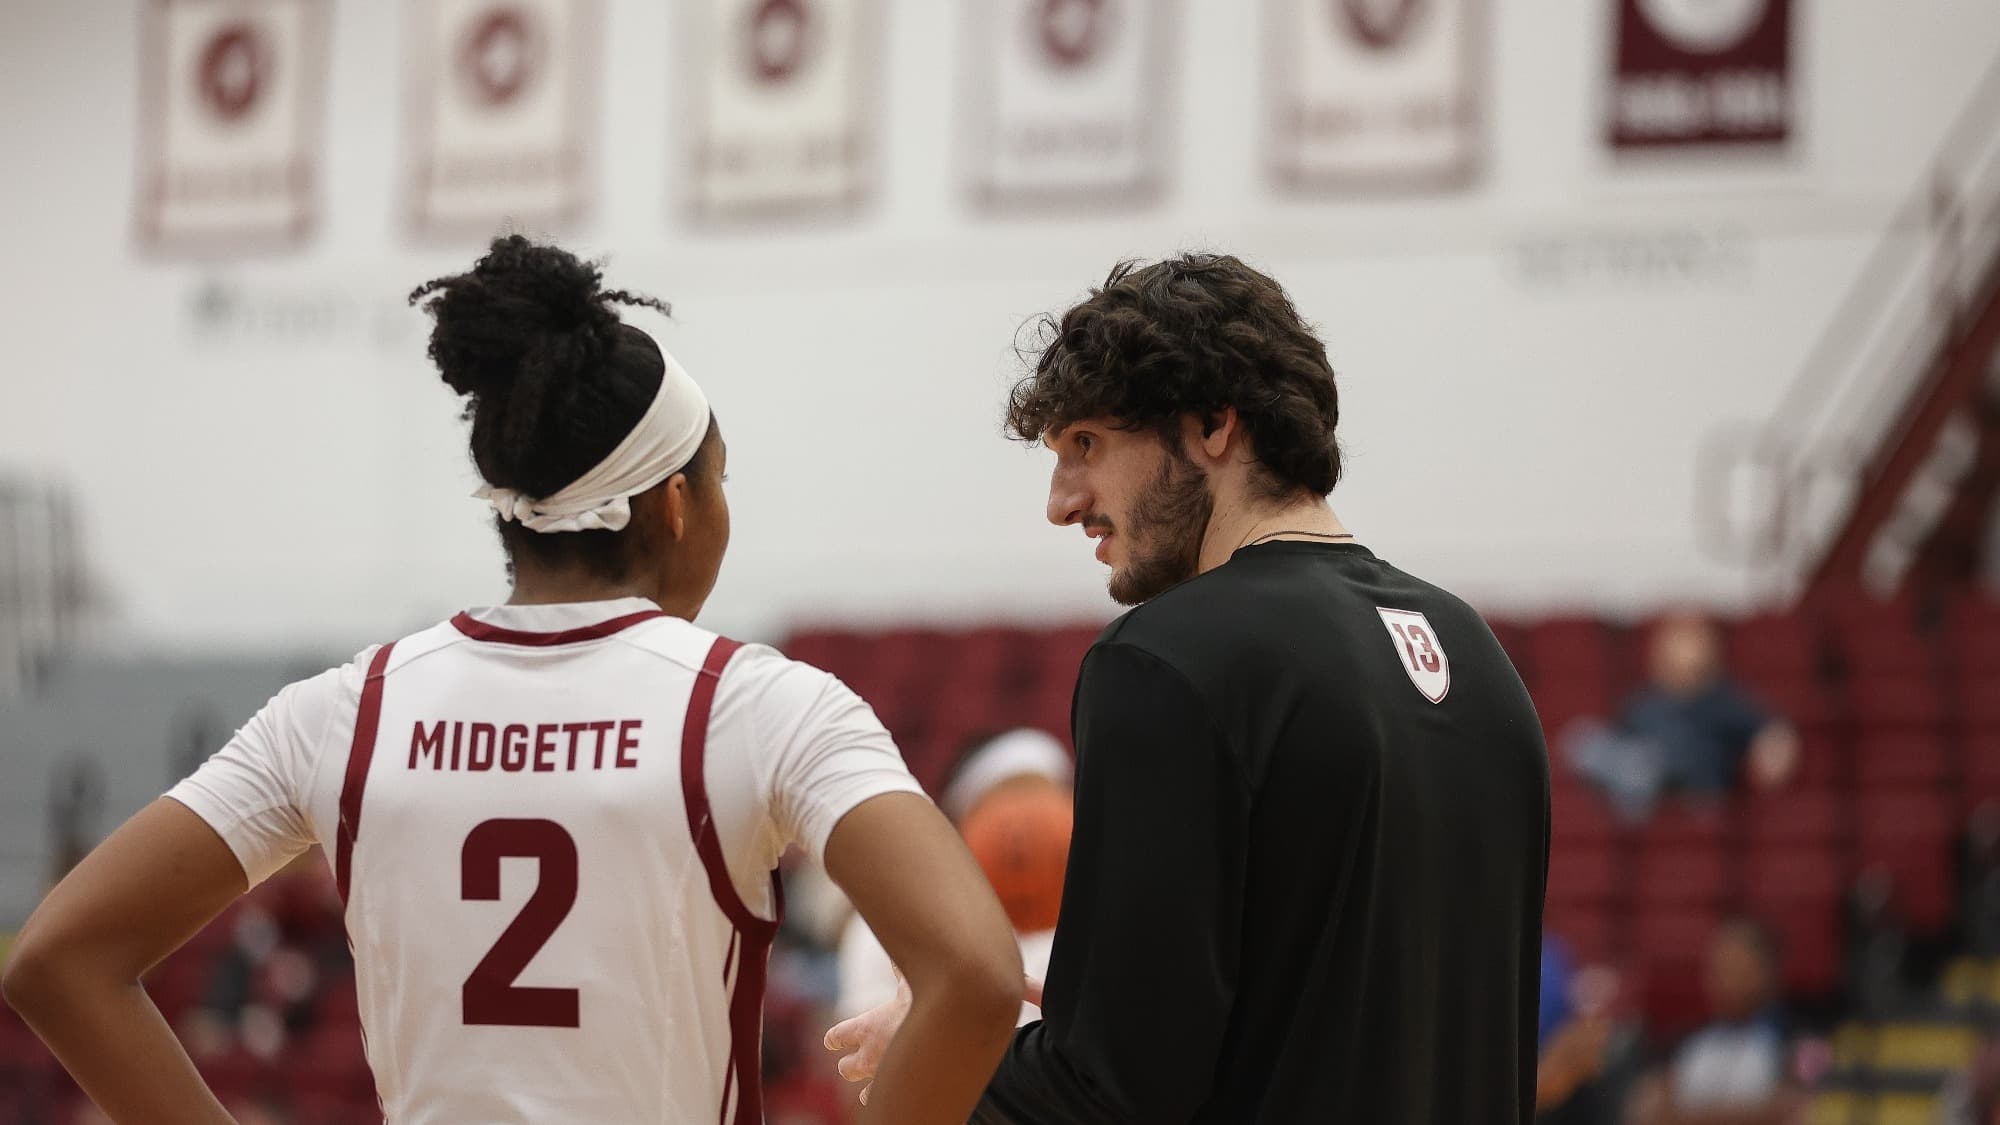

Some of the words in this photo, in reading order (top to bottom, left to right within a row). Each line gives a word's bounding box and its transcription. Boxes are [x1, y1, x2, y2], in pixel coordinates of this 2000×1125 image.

[1391, 623, 1440, 673] 13
[407, 719, 643, 772] MIDGETTE
[460, 817, 581, 1028] 2
